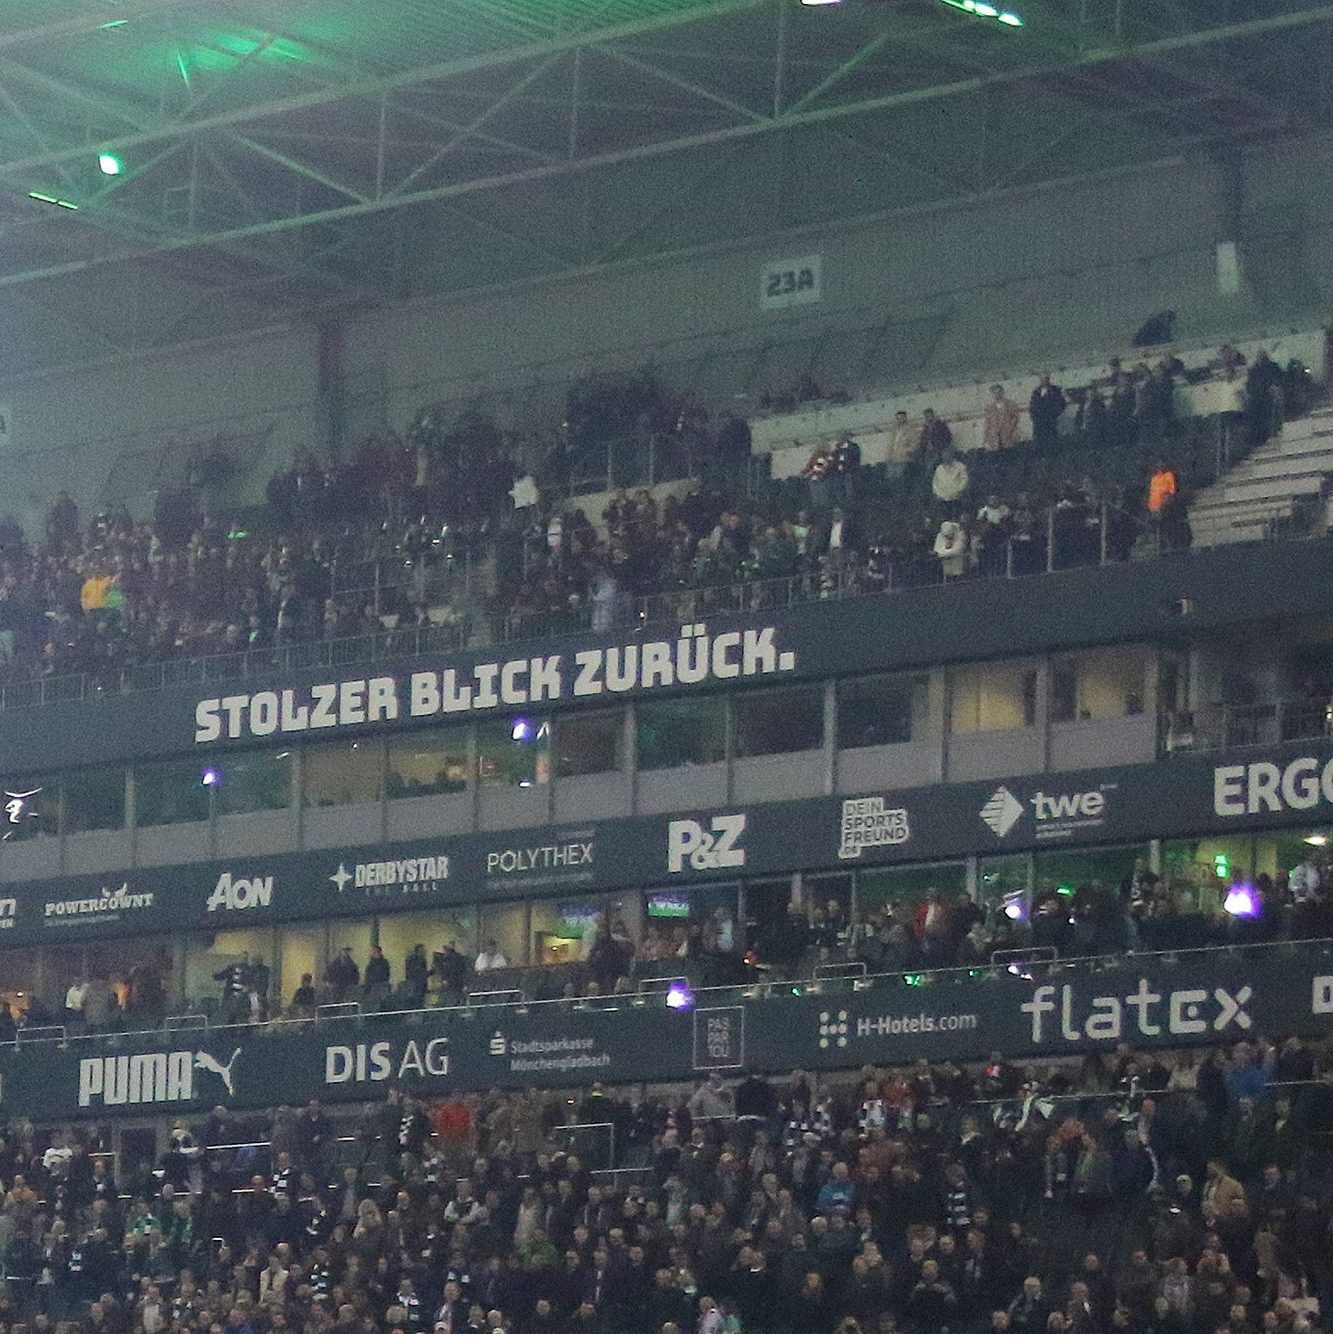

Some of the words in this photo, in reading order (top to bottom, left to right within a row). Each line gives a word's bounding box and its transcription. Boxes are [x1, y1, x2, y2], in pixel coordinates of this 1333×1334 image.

[194, 676, 398, 742] STOLZER
[410, 654, 561, 716] BLICK
[573, 623, 795, 697] ZURÜCK.
[845, 801, 882, 816] DEIN
[1030, 790, 1105, 820] twe
[843, 826, 907, 844] FREUND
[844, 812, 904, 830] SPORTS
[487, 842, 593, 873] POLYTHEX
[668, 813, 746, 873] P&Z
[354, 855, 449, 888] DERBYSTAR
[206, 872, 274, 912] AON
[856, 1013, 977, 1037] H-Hotels.com
[510, 1038, 594, 1054] Stadtsparkasse
[79, 1050, 193, 1107] PUMA
[510, 1054, 611, 1073] Mönchengladbach
